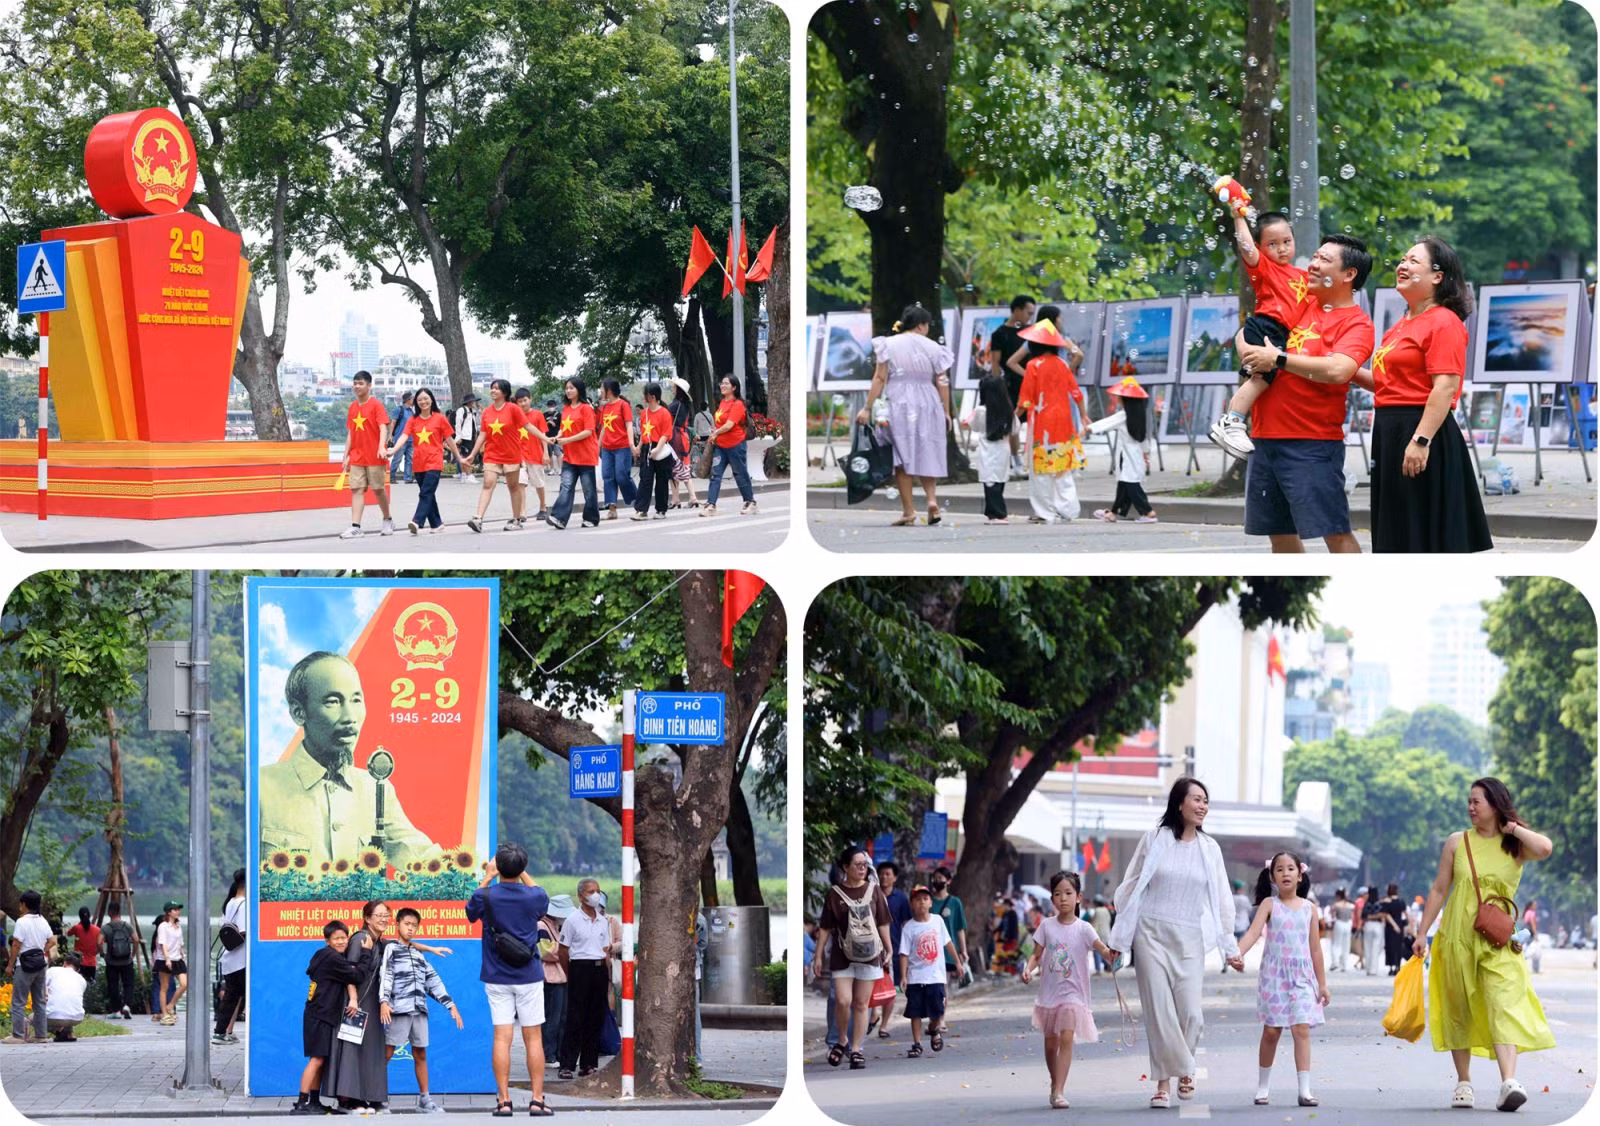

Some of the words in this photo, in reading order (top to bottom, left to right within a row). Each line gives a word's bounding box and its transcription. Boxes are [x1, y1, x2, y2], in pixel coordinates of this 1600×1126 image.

[169, 226, 204, 262] 2-9
[674, 698, 701, 710] PHỐ
[390, 712, 418, 723] 1945
[432, 712, 461, 723] 2024
[644, 718, 664, 735] ĐINH
[668, 716, 686, 736] TIÊN
[688, 716, 716, 736] HOÀNG
[591, 752, 607, 764] PHỐ
[575, 770, 594, 790] HÀNG
[597, 772, 616, 788] KHAY
[280, 908, 304, 922] NHIỆT
[307, 908, 324, 922] LIỆT
[327, 907, 349, 920] CHÀO
[277, 924, 300, 936] NƯỚC
[426, 922, 444, 938] VIỆT
[446, 924, 466, 935] NAM
